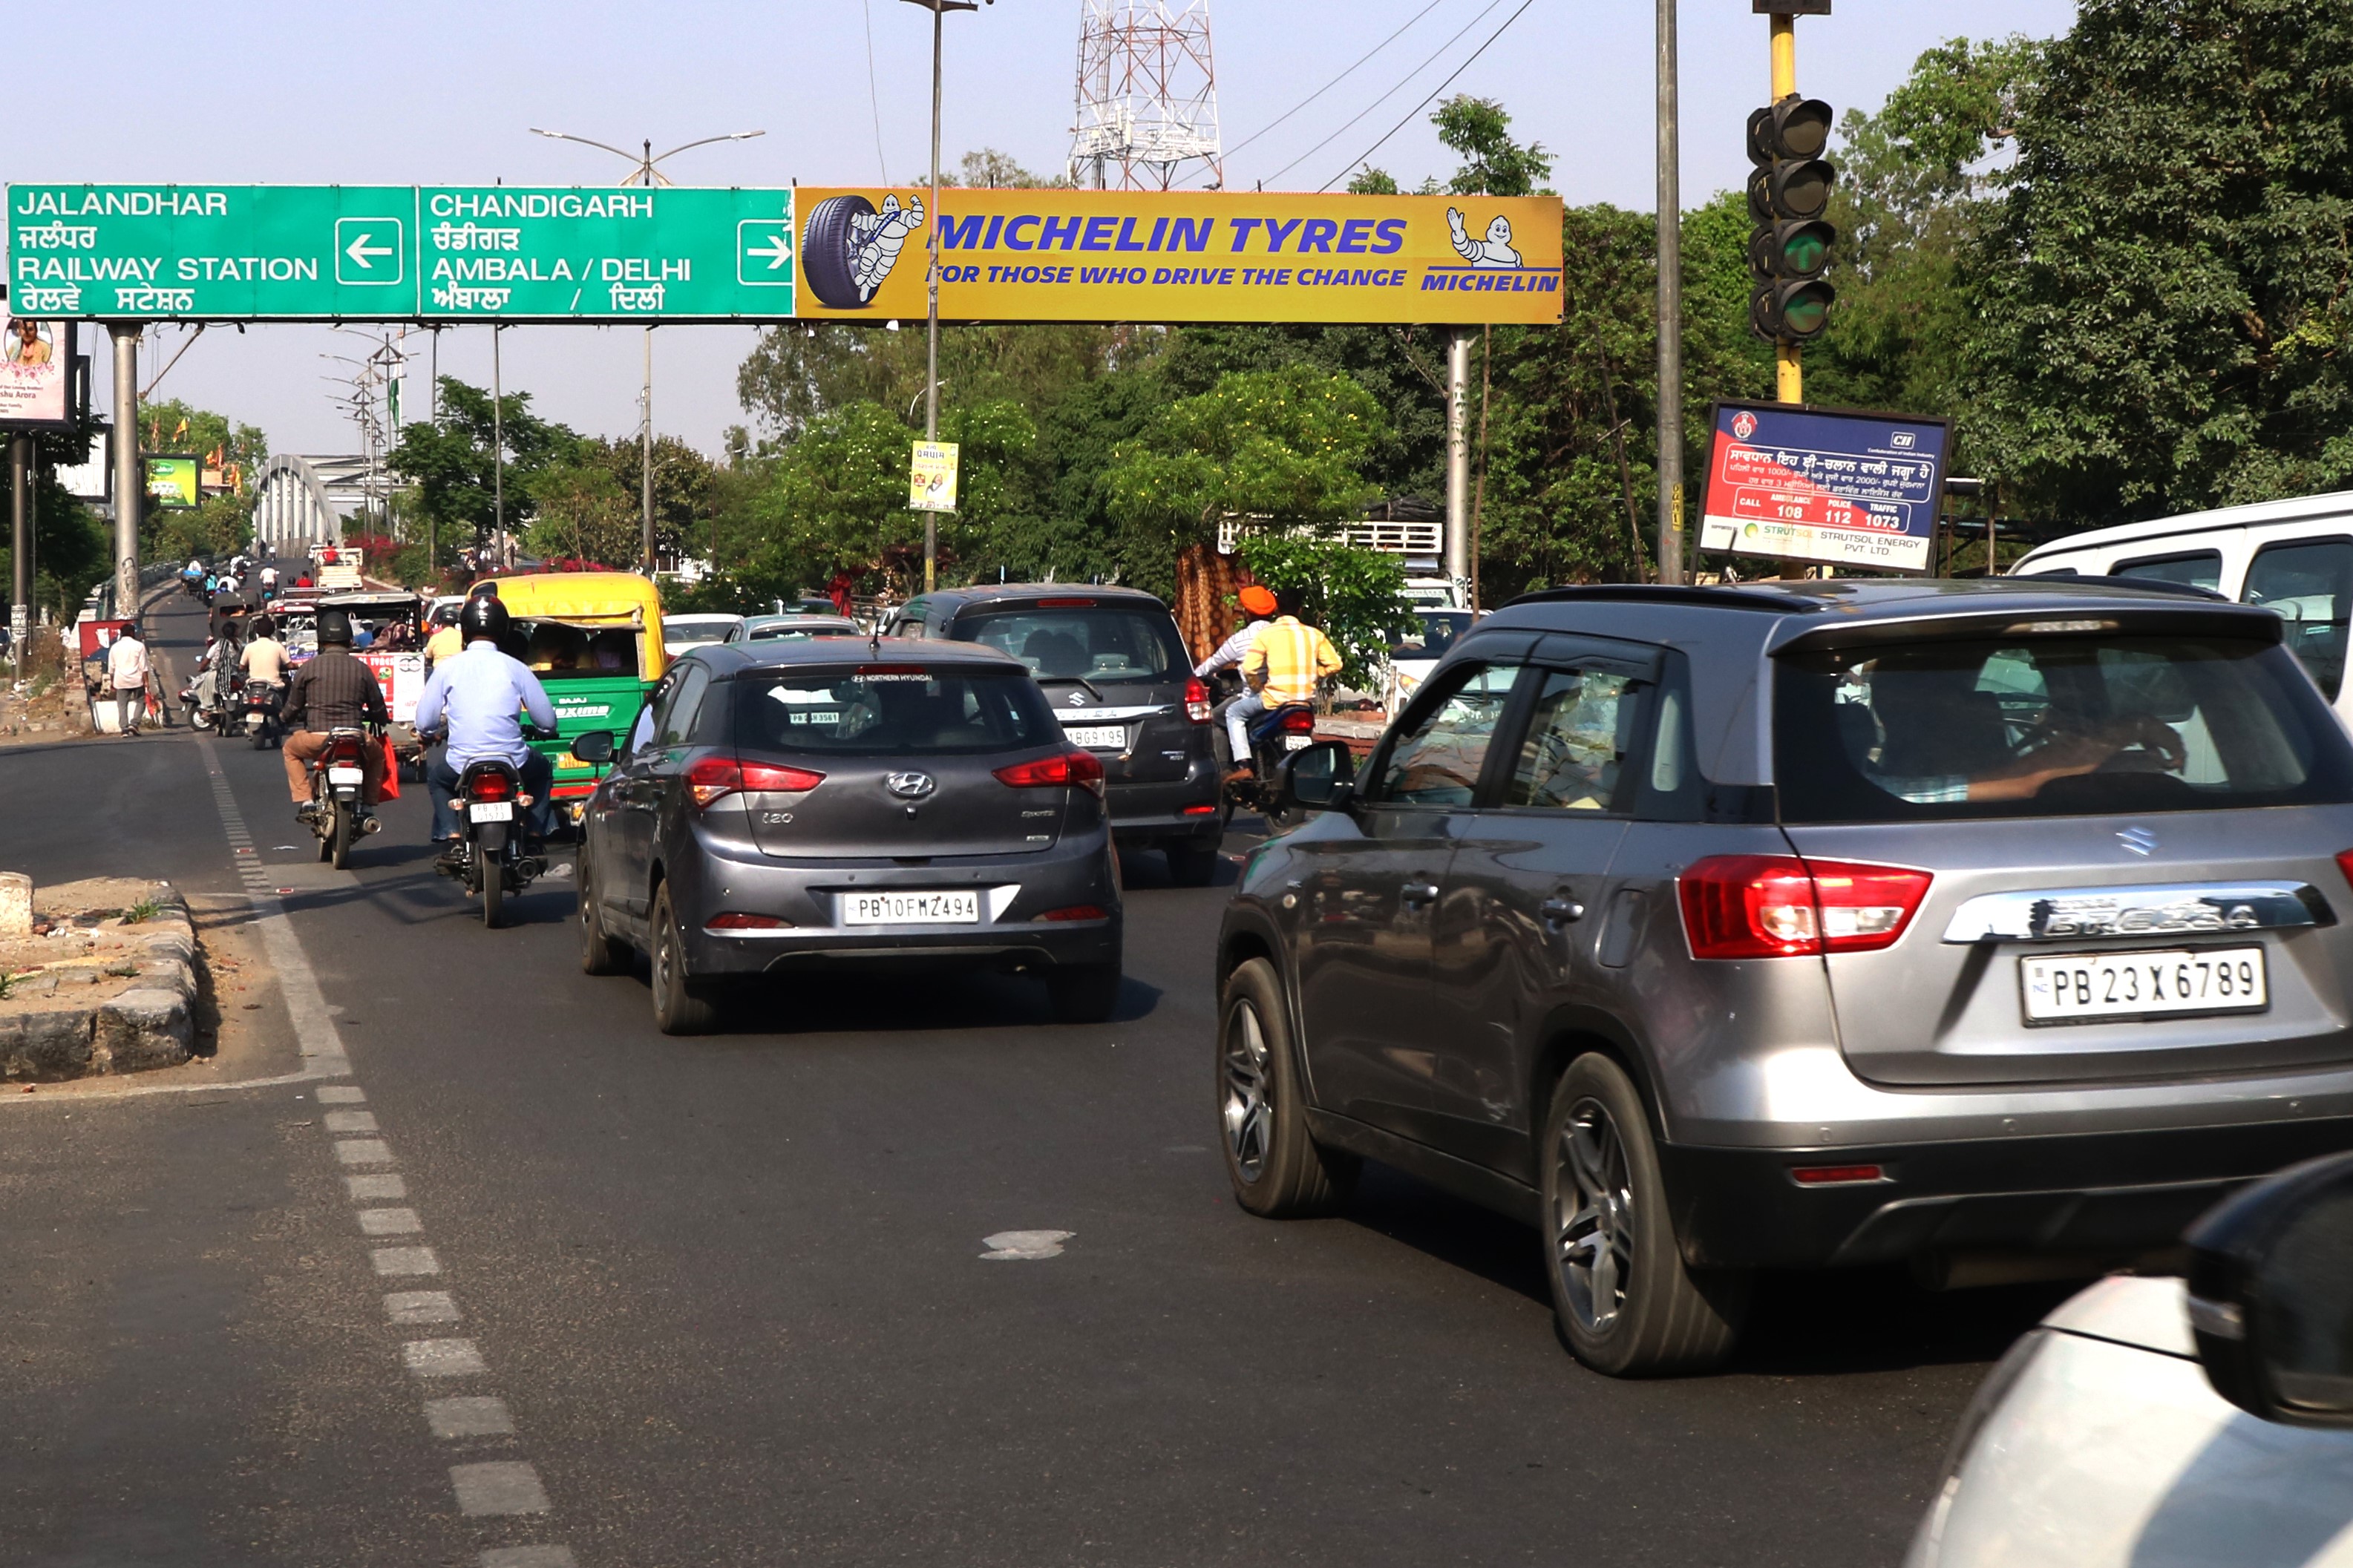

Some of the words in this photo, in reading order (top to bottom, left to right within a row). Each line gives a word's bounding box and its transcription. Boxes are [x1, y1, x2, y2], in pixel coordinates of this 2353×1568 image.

[17, 192, 227, 216] JALANDHAR
[430, 194, 653, 218] CHANDIGARH
[17, 220, 97, 249] ਜਲੰਧਰ
[925, 214, 1210, 253] MICHELIN
[1229, 217, 1407, 255] TYRES
[18, 257, 162, 281] RAILWAY
[177, 257, 318, 281] STATION
[431, 257, 573, 281] AMBALA
[601, 258, 690, 281] DELHI
[925, 264, 980, 283] FOR
[986, 265, 1074, 285] THOSE
[1079, 266, 1148, 285] WHO
[1152, 267, 1236, 286] DRIVE
[1242, 268, 1292, 286] THE
[1296, 269, 1408, 287] CHANGE
[431, 281, 511, 310] ਅੰਬਾਲਾ
[1420, 275, 1560, 292] MICHELIN
[19, 281, 82, 311] ਰੇਲਵੇ
[114, 281, 195, 311] ਸਟੇਸ਼ਨ
[1893, 435, 1913, 446] CII
[1729, 450, 1773, 464] ਸਾਵਧਾਨ
[1777, 451, 1799, 466] ਇਹ
[1861, 461, 1888, 475] ਵਾਲੀ
[1739, 497, 1761, 508] CALL
[1770, 493, 1812, 505] AMBULANCE
[1827, 499, 1852, 509] POLICE
[1870, 503, 1898, 514] TRAFFIC
[1777, 505, 1803, 519] 108
[1825, 510, 1852, 524] 112
[1865, 514, 1900, 529] 1073
[1820, 531, 1873, 545] STRUTSOL
[1877, 537, 1921, 549] ENERGY
[866, 674, 900, 682] NORTHERN
[900, 674, 933, 682] HYUNDAI
[552, 706, 609, 719] axima
[859, 899, 974, 917] PB10FM2494
